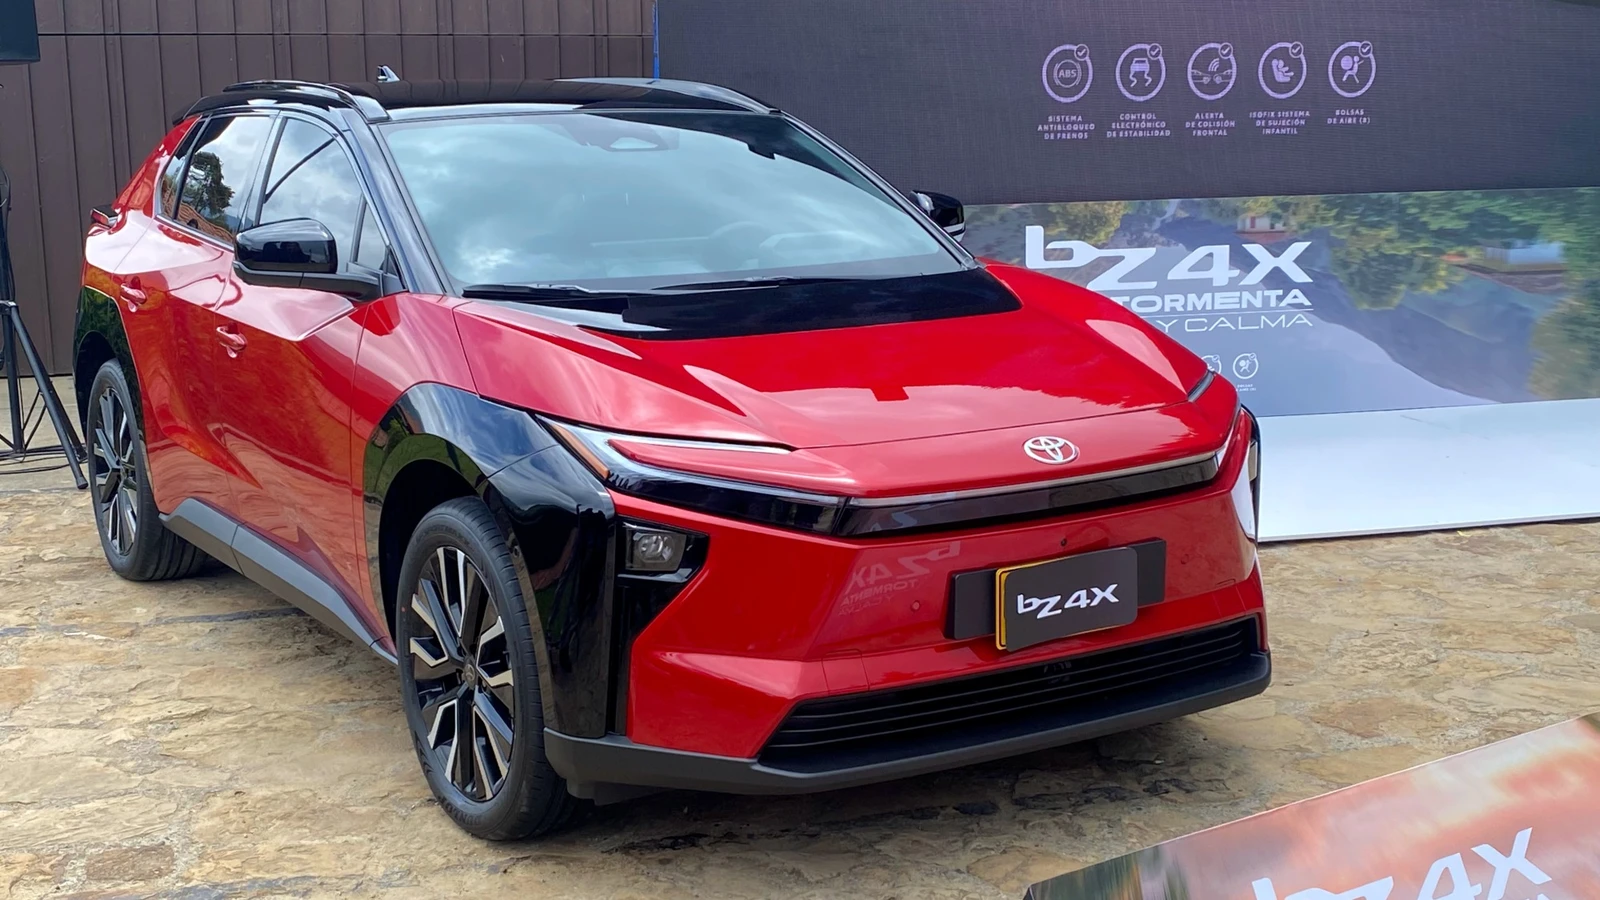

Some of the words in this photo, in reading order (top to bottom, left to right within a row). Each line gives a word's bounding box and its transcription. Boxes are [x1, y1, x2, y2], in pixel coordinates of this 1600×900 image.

[1058, 69, 1077, 78] ABS
[1120, 112, 1157, 120] CONTROL
[1277, 110, 1310, 118] SISTEMA
[1111, 120, 1166, 129] ELECTRÓNICO
[1198, 119, 1235, 128] COLISIÓN
[1268, 118, 1305, 126] SUJECIÓN
[1037, 123, 1095, 131] ANTIBLOQUEO
[1262, 127, 1298, 135] INFANTIL
[1044, 132, 1054, 140] DE
[1106, 130, 1117, 138] DE
[1119, 129, 1171, 137] ESTABILIDAD
[1156, 319, 1178, 333] Y
[1185, 314, 1313, 332] CALMA
